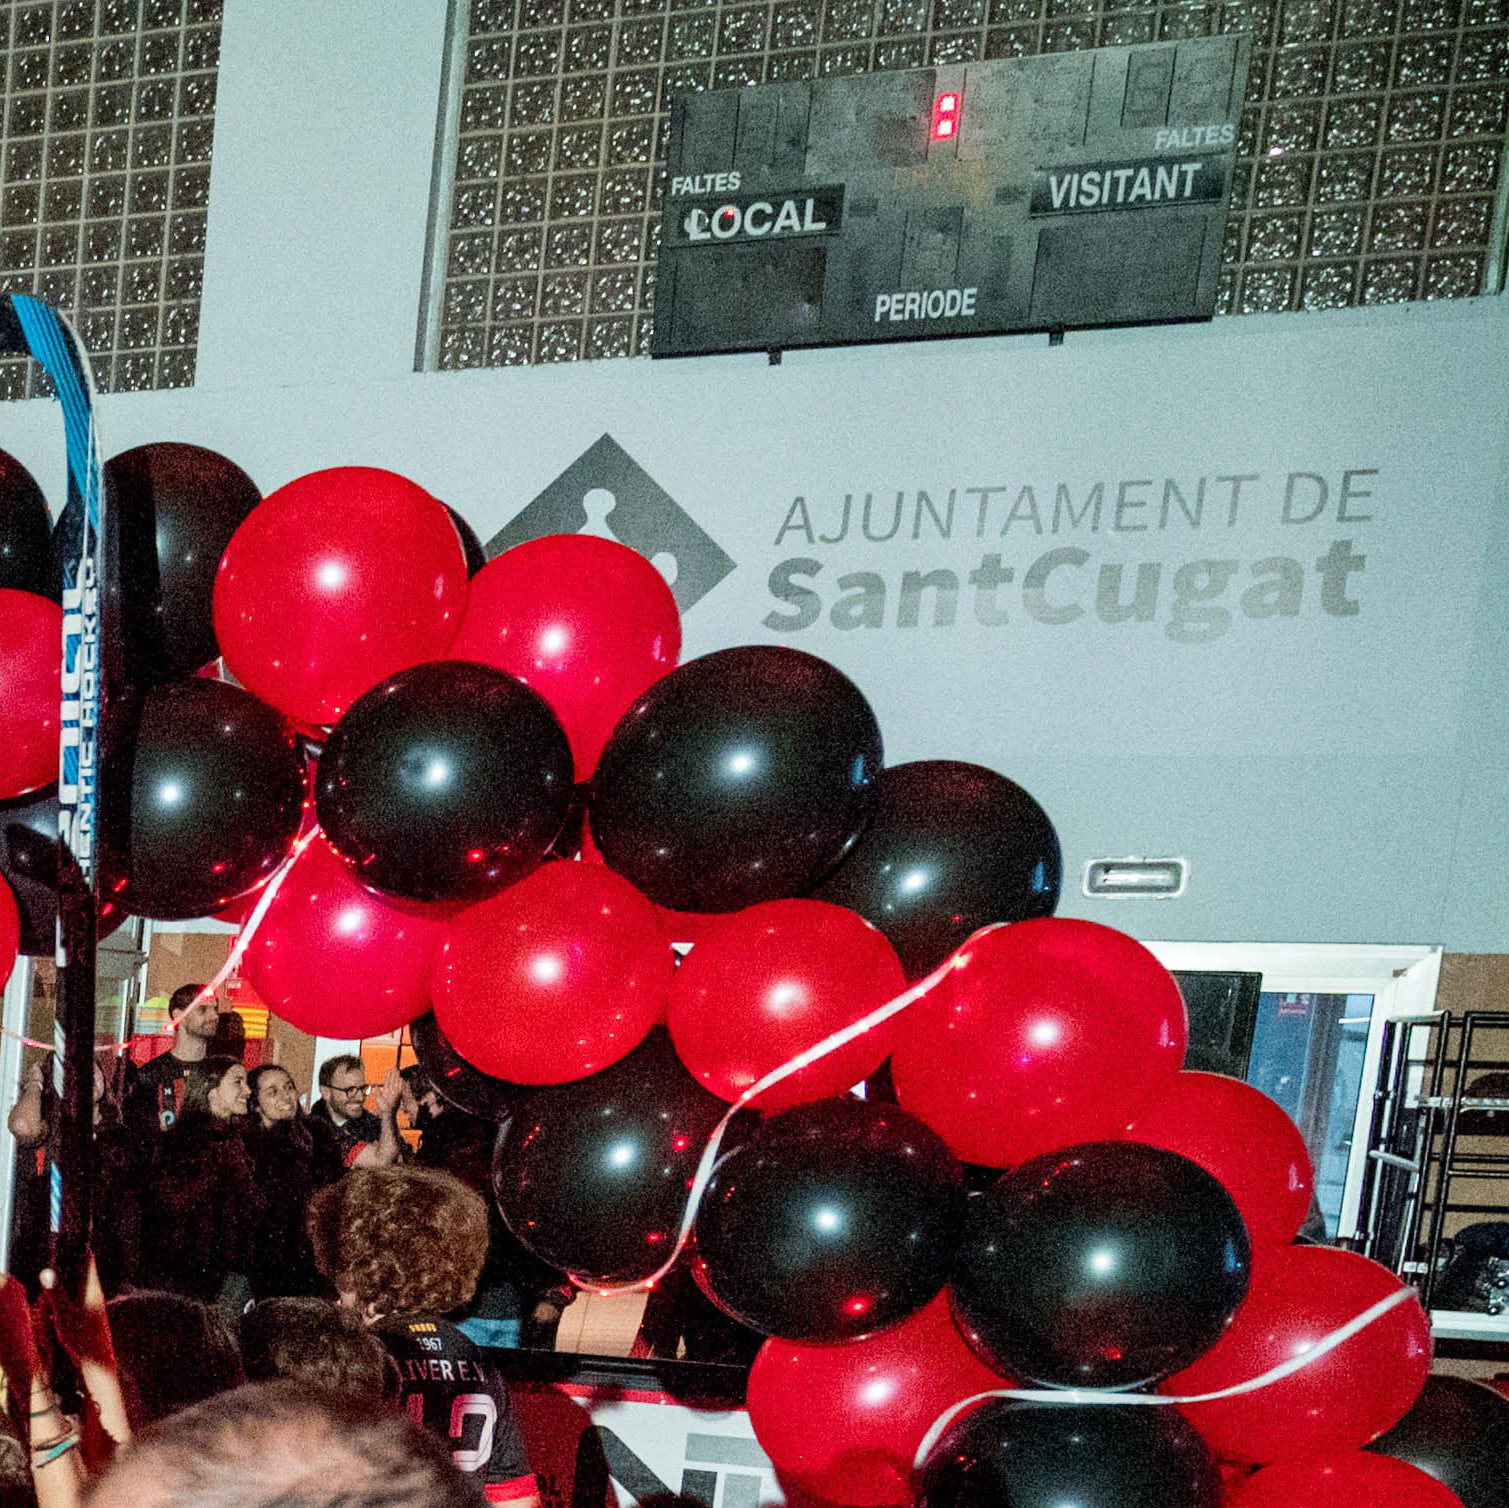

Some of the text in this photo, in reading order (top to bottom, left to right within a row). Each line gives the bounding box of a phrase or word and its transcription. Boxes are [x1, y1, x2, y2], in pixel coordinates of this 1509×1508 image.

[1154, 124, 1235, 150] FALTES
[671, 172, 742, 195] FALTES
[1050, 162, 1202, 209] VISITANT
[687, 198, 827, 240] LOCAL
[874, 287, 978, 322] PERIODE
[773, 469, 1379, 546] AJUNTAMENT DE
[761, 539, 1368, 646] SantCugat
